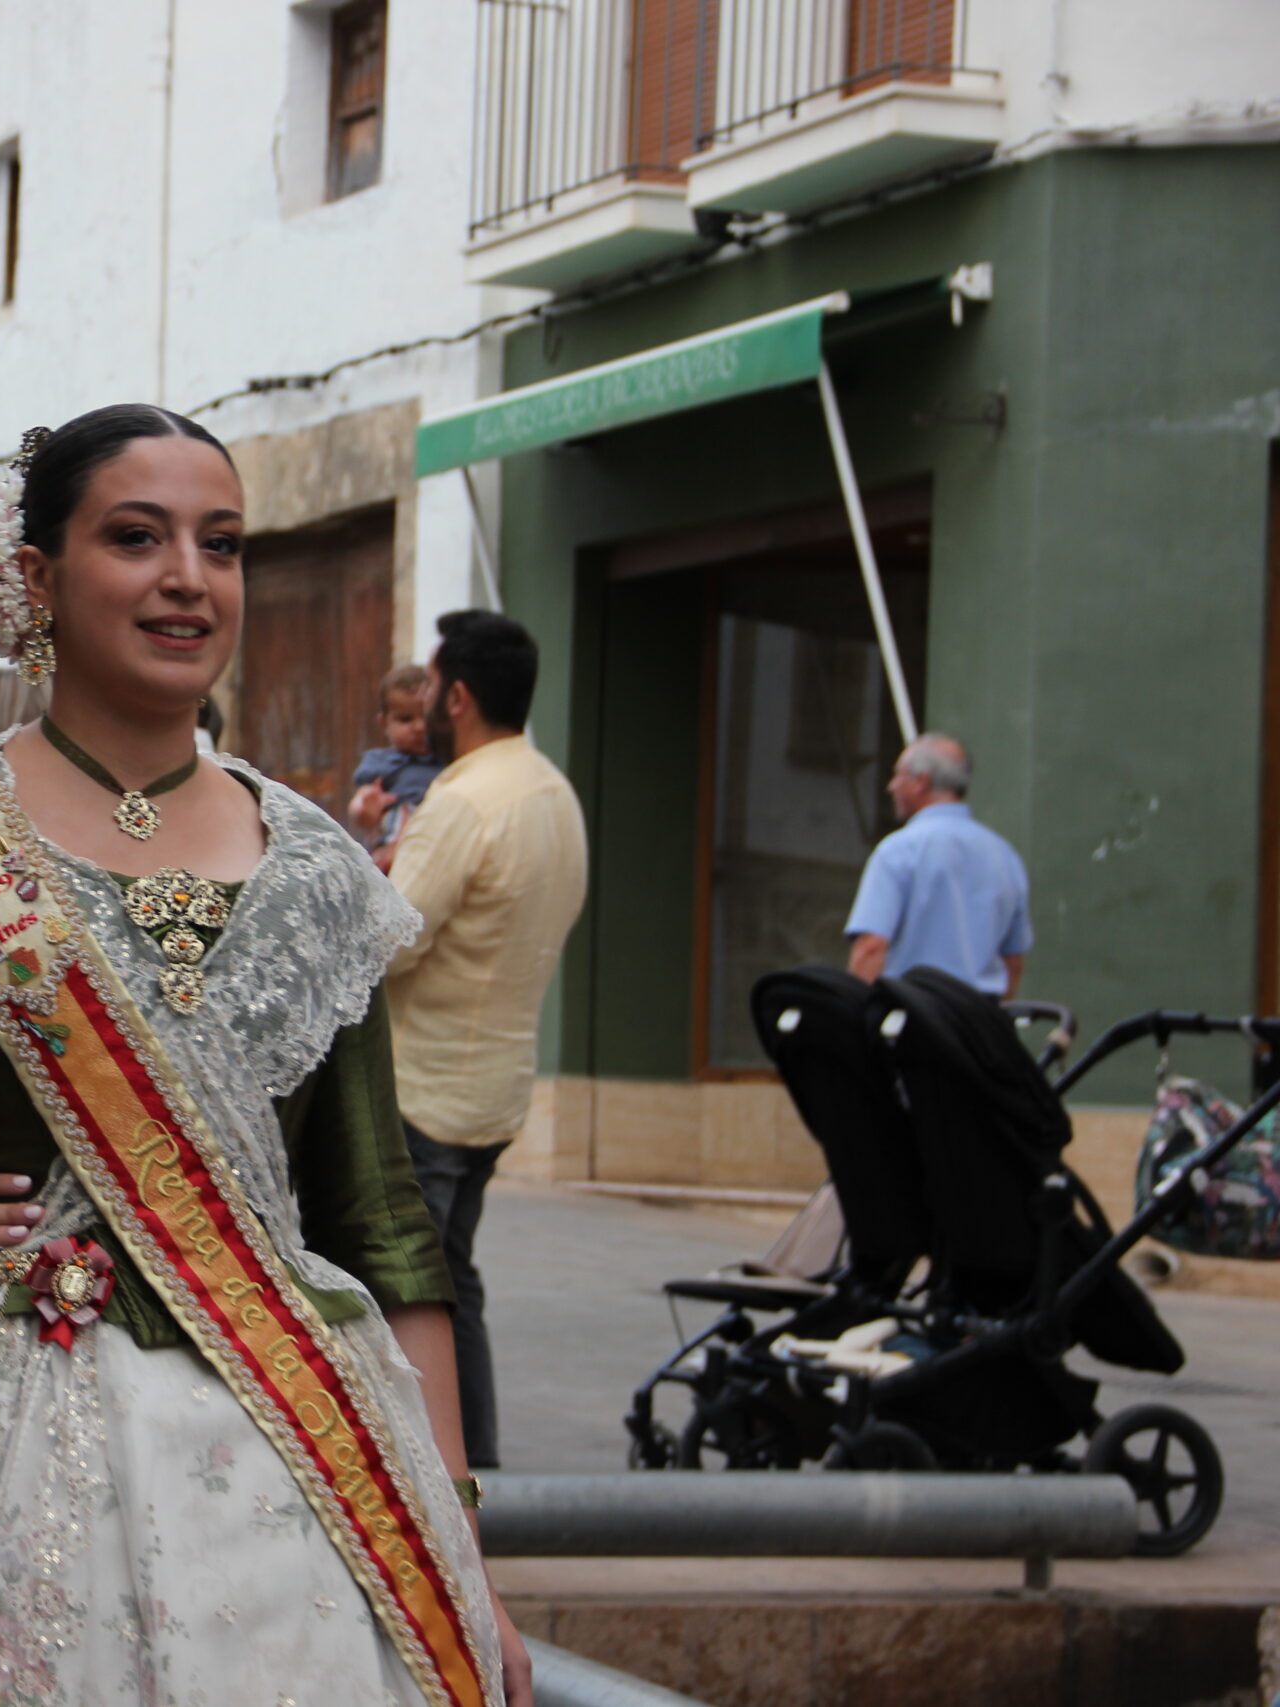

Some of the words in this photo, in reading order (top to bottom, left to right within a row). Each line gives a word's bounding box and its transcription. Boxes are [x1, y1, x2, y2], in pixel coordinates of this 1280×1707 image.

[128, 1118, 223, 1266] Reina
[222, 1277, 265, 1329] de
[265, 1334, 301, 1383] la
[296, 1389, 419, 1592] Foguera
